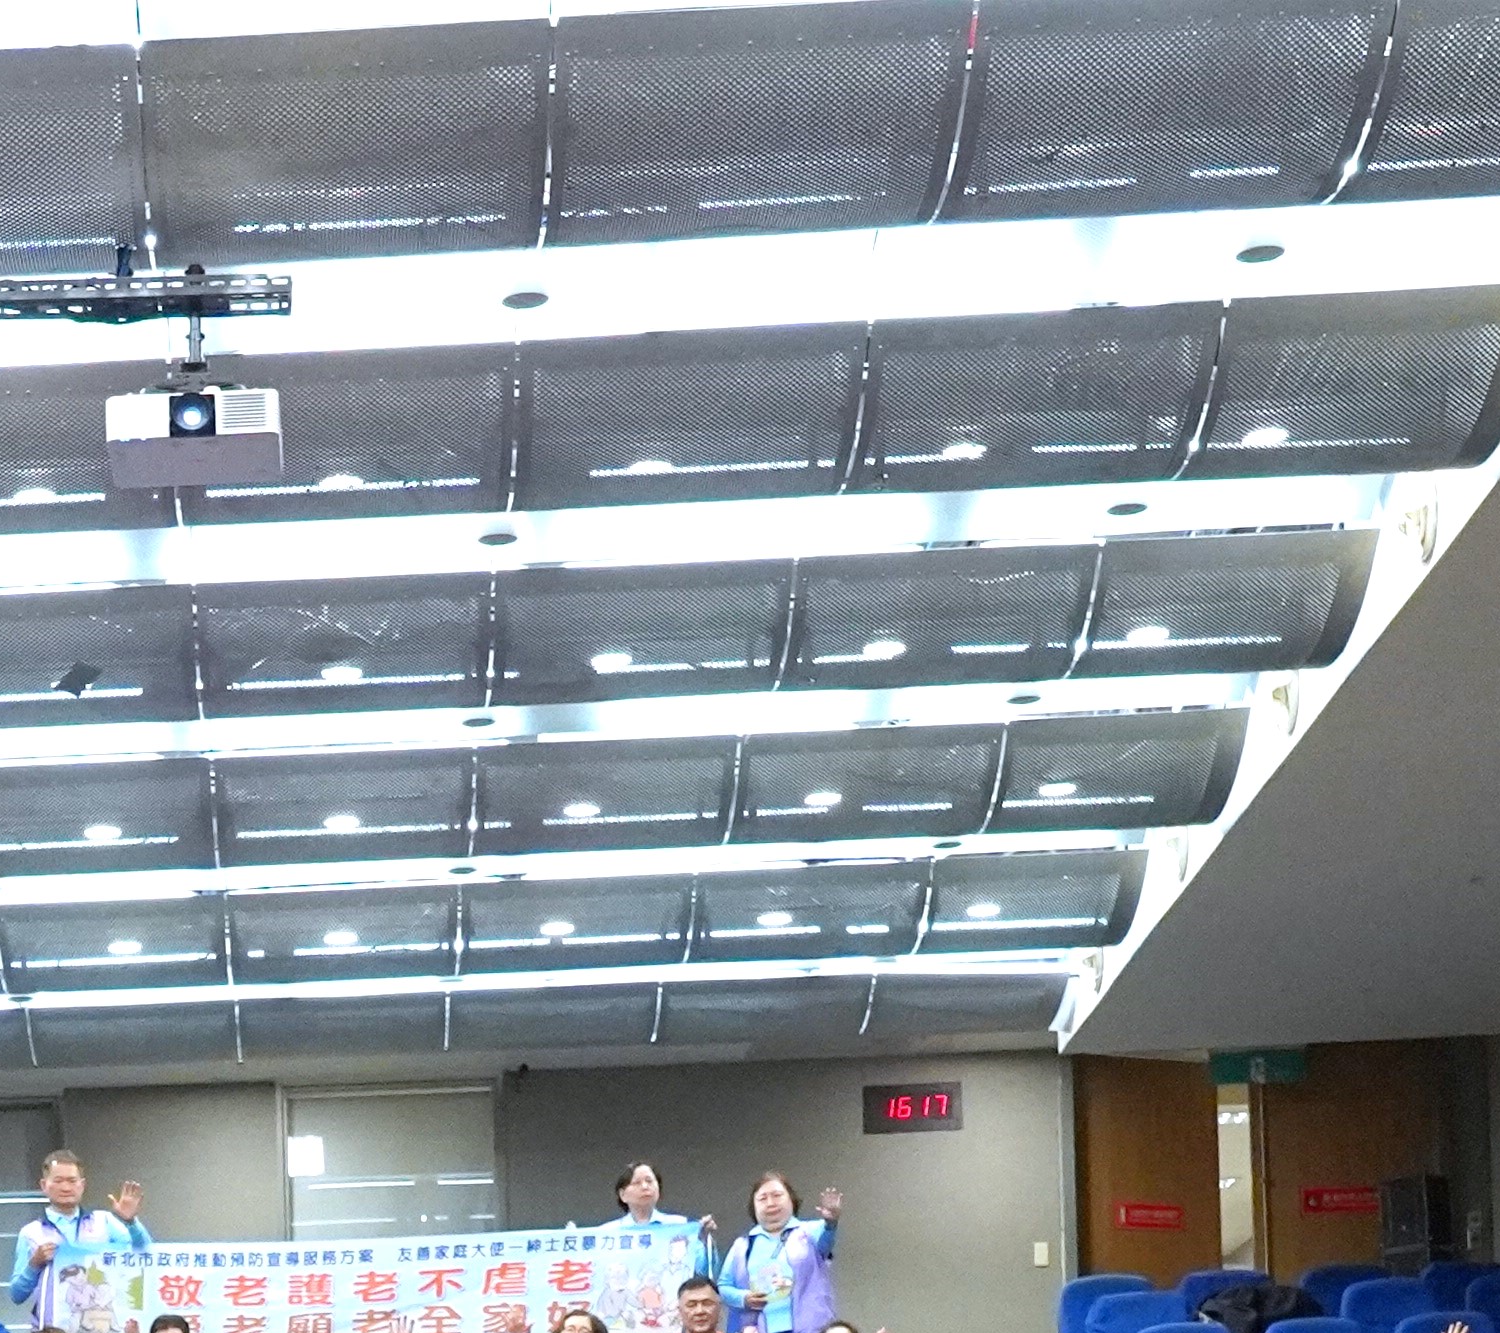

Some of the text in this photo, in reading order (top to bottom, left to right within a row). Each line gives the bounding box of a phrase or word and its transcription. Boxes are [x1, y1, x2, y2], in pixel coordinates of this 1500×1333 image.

[158, 1260, 592, 1307] 敬老護老不虐老
